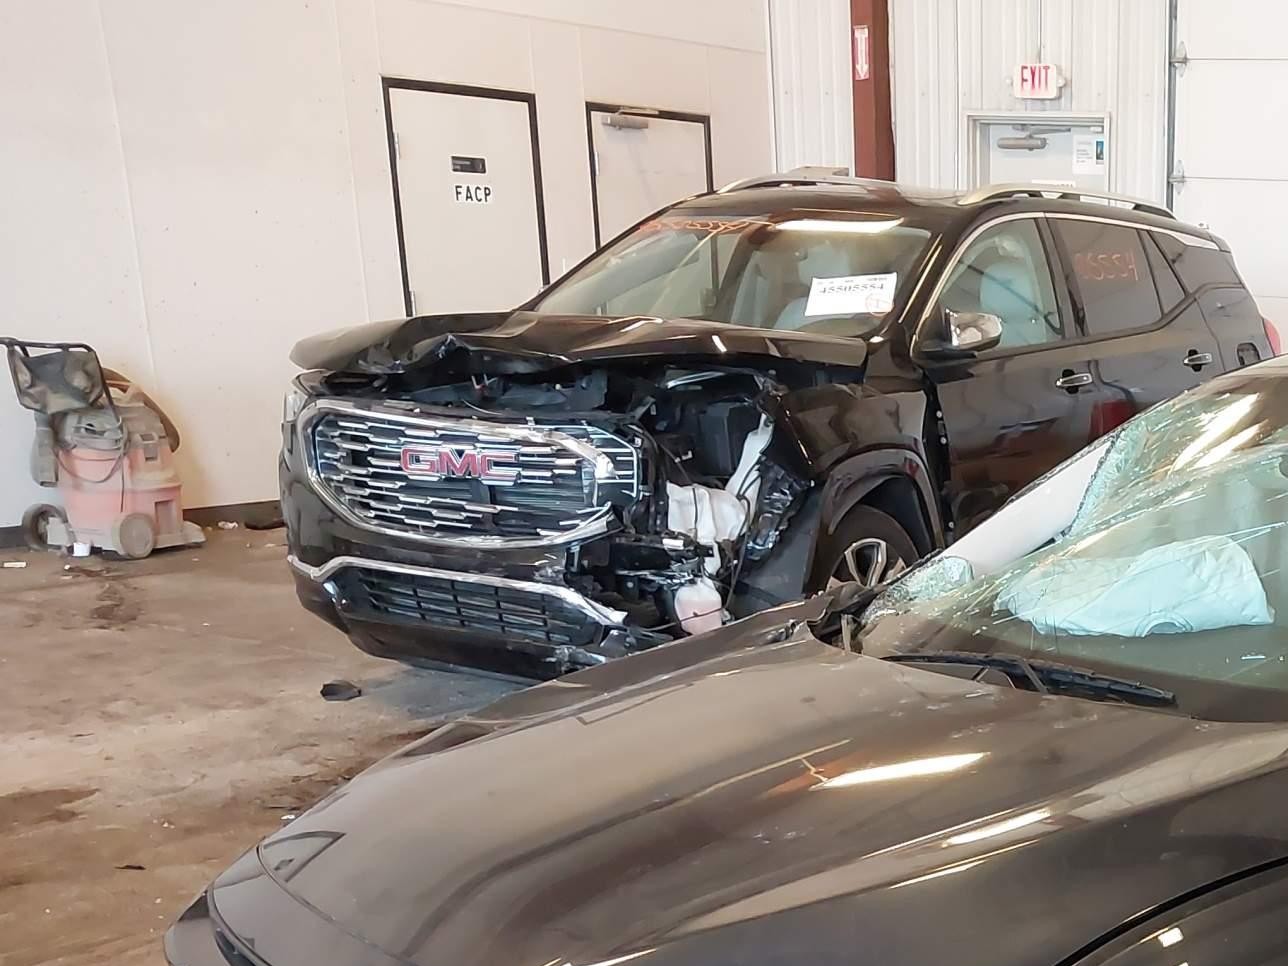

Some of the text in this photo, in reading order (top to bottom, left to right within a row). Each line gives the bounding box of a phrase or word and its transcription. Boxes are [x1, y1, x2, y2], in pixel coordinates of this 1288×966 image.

[1021, 65, 1050, 92] EXIT
[455, 185, 491, 202] FACP
[401, 447, 516, 480] GMC
